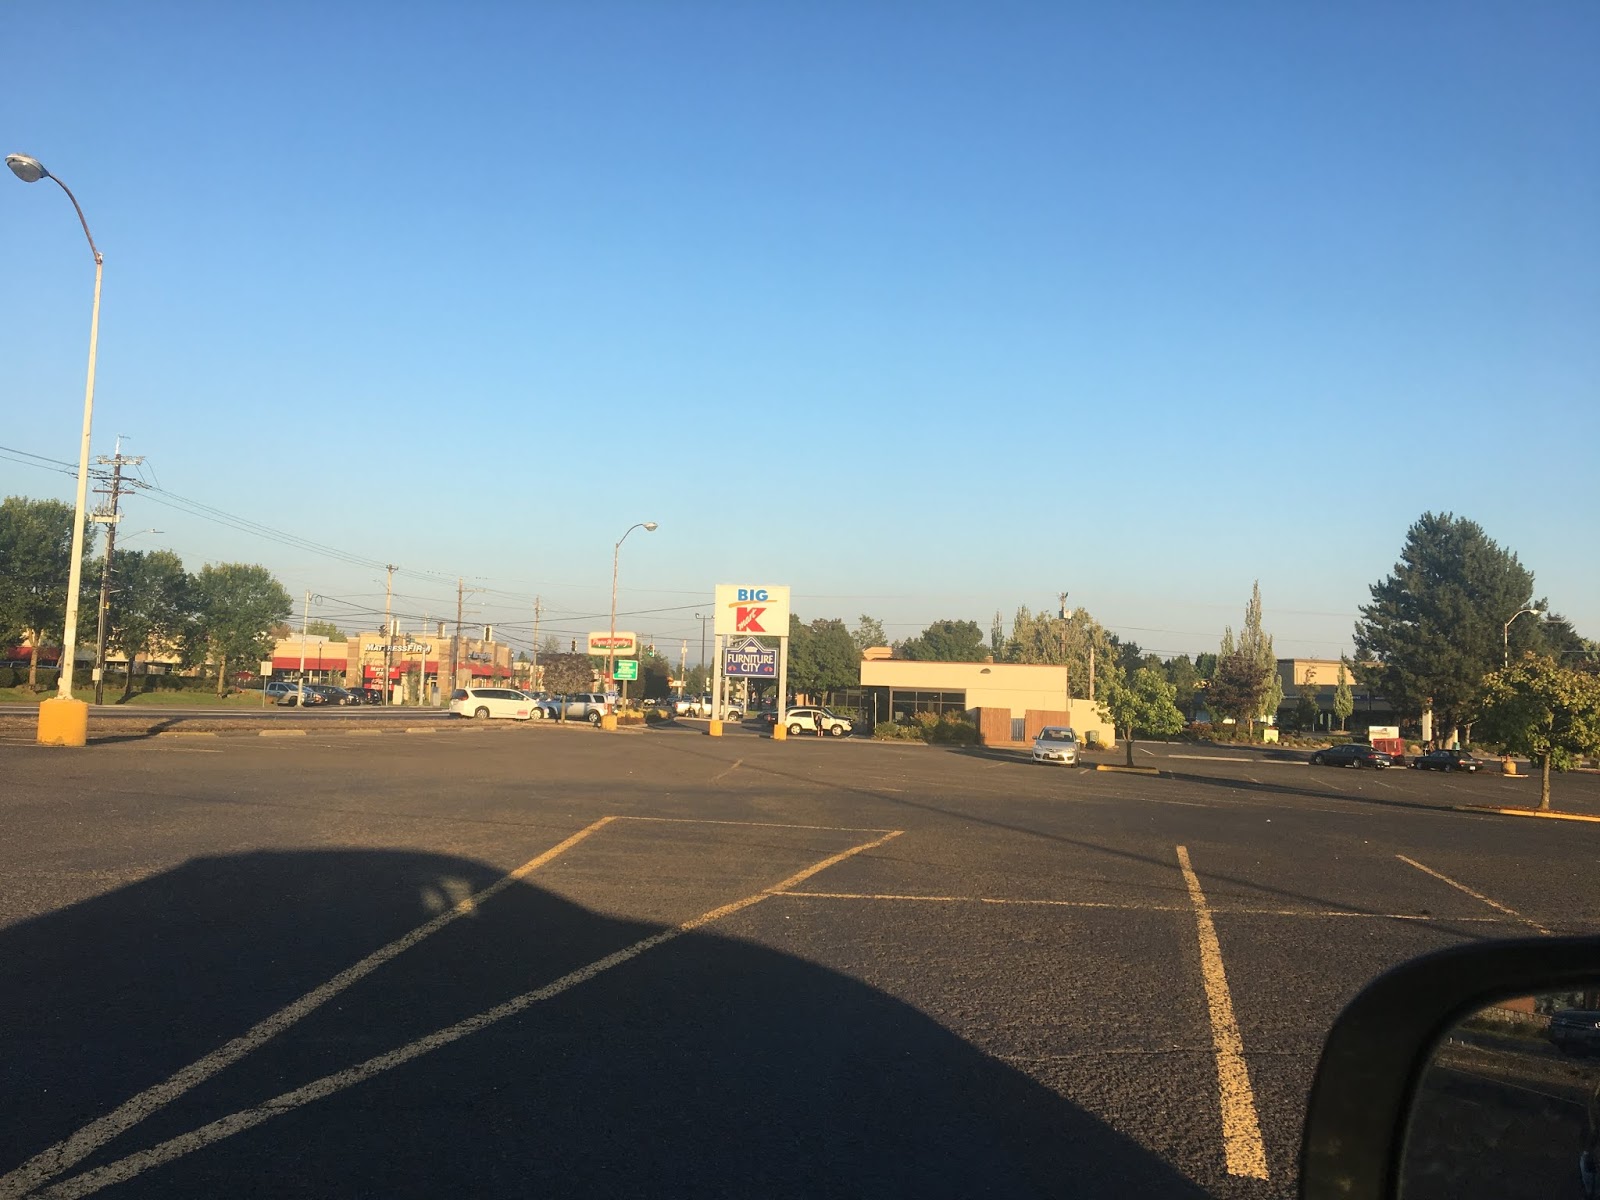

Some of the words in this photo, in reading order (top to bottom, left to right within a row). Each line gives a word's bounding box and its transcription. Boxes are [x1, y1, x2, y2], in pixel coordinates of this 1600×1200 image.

[738, 589, 768, 602] BIG
[736, 607, 767, 633] K
[728, 654, 774, 664] FURNITURE
[741, 663, 760, 673] CITY
